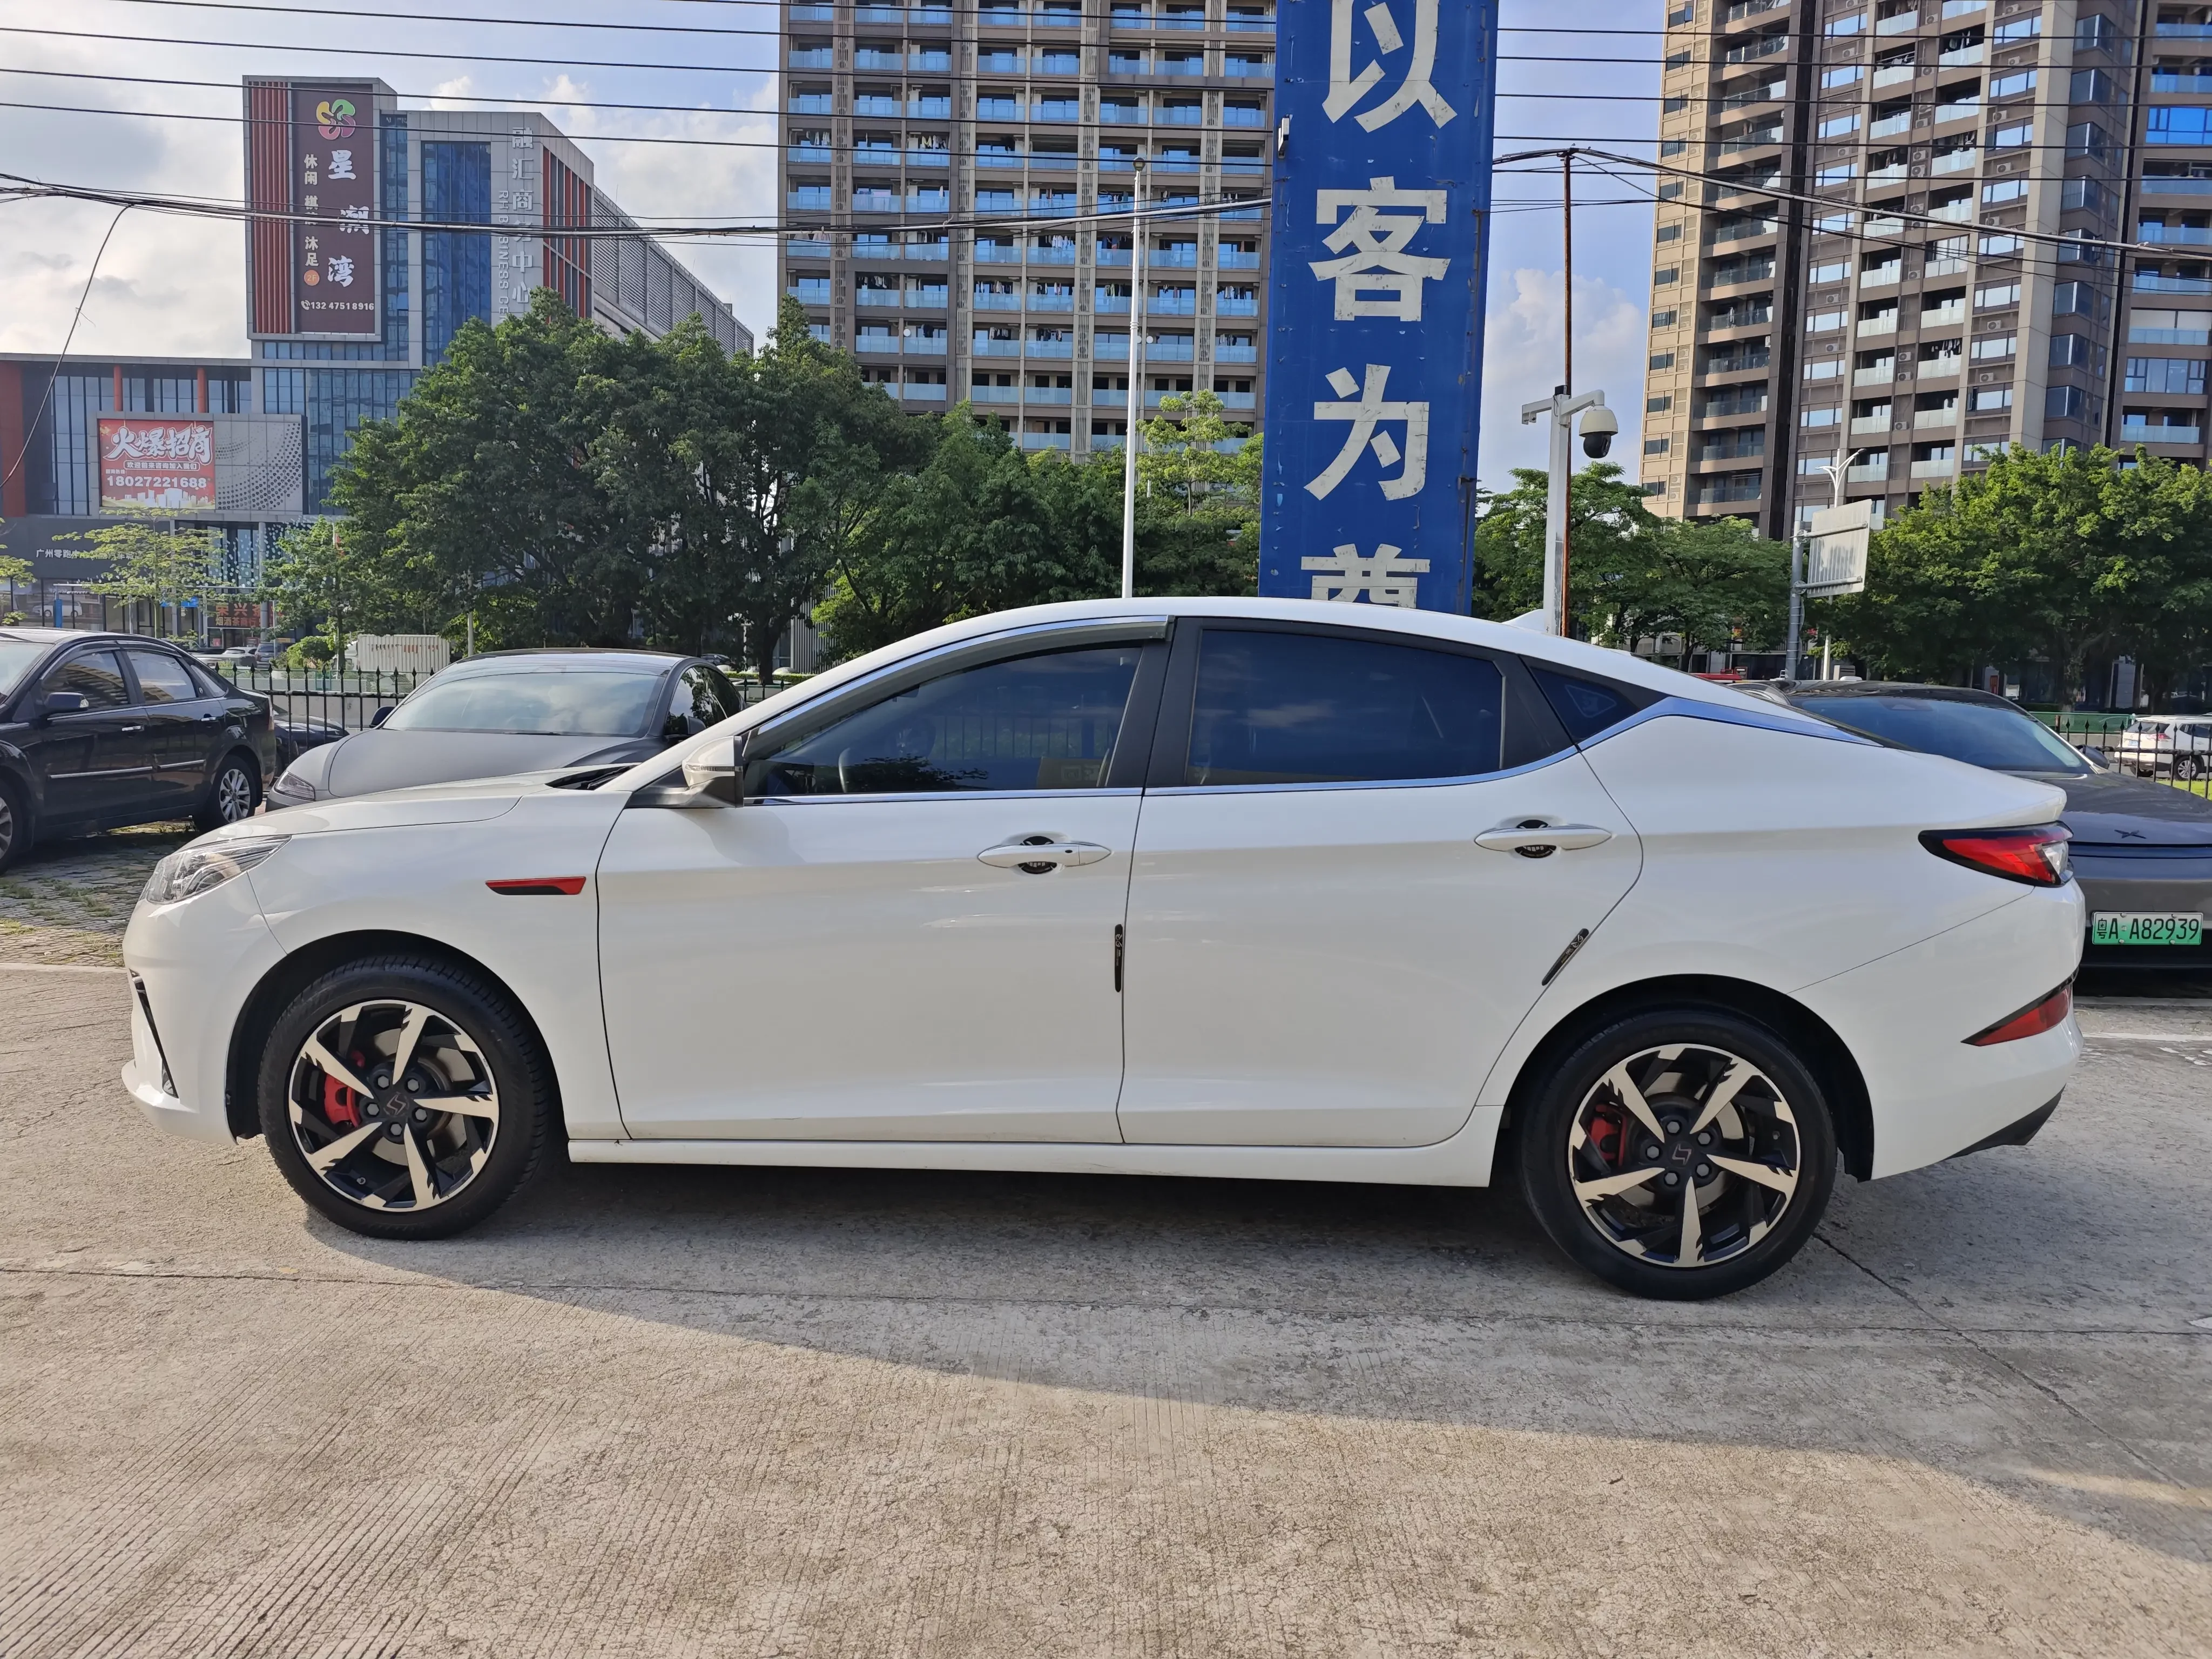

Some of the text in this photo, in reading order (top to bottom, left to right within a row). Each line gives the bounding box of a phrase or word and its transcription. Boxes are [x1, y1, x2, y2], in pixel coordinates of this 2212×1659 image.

[499, 190, 509, 210] RH
[305, 236, 319, 266] 沐足
[103, 423, 212, 466] 火爆招商
[107, 475, 207, 488] 18027221688
